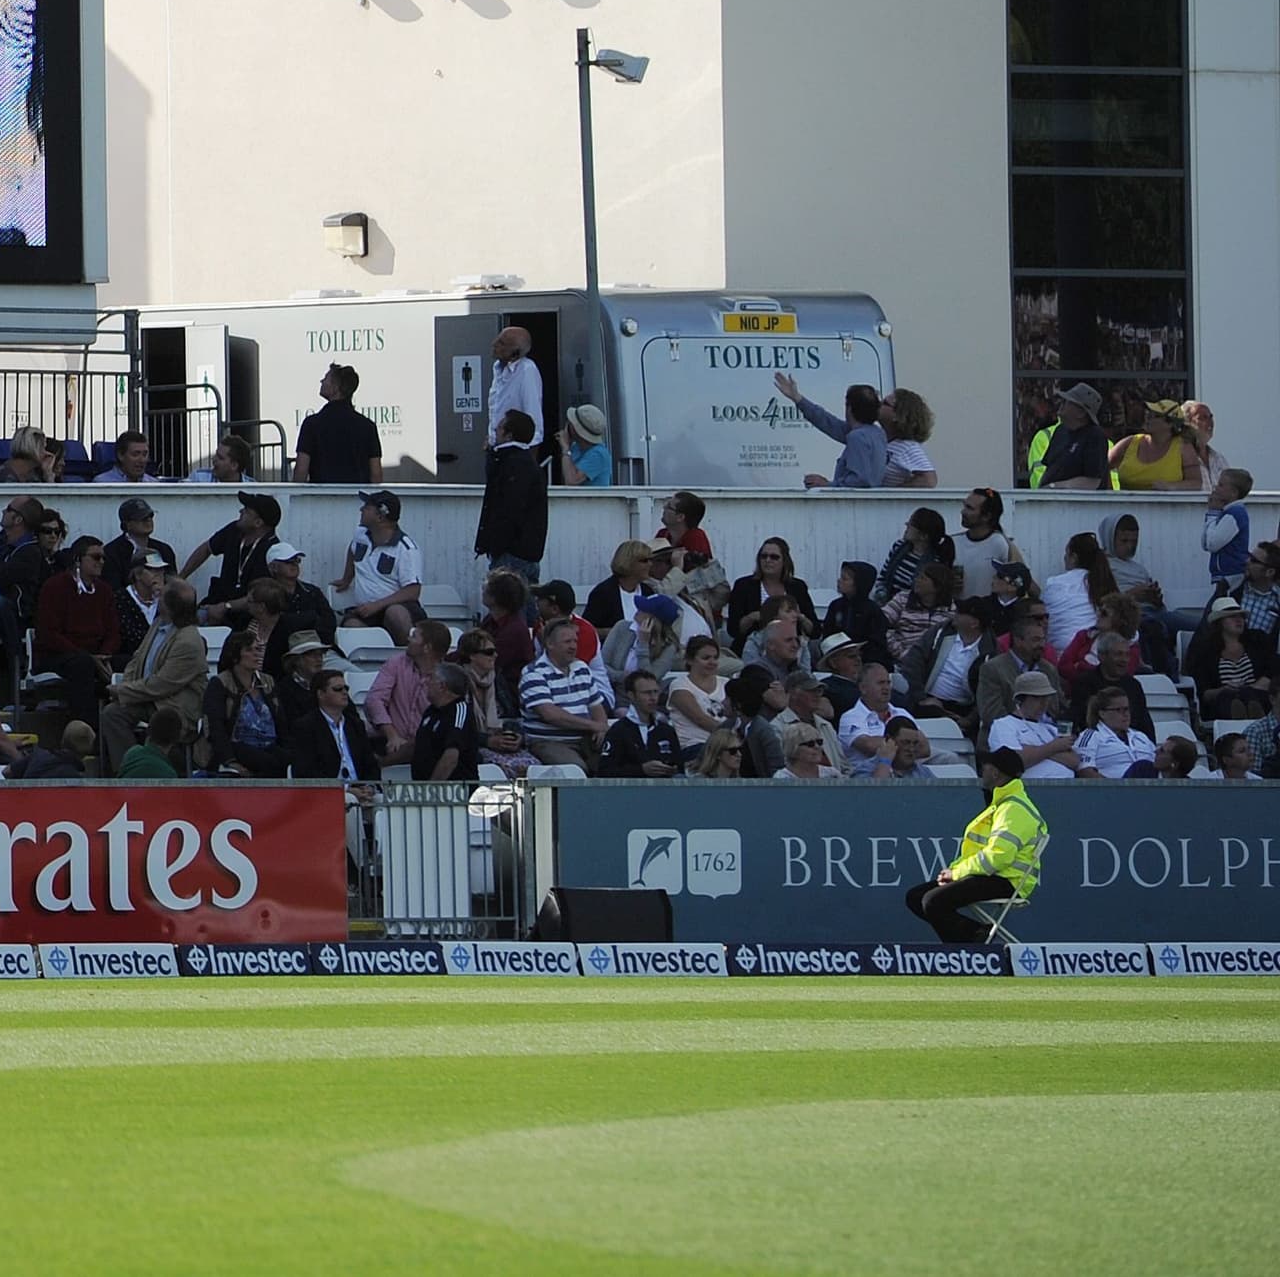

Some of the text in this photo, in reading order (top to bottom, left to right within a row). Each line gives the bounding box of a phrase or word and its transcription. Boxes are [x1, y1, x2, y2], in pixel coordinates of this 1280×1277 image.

[764, 317, 779, 331] JP
[306, 328, 385, 353] TOILETS
[704, 344, 821, 370] TOILETS
[456, 397, 480, 409] GENTS
[692, 852, 737, 873] 1762
[71, 945, 171, 976] Investec
[210, 944, 306, 975] Investec
[340, 943, 438, 975] Investec
[473, 943, 571, 974] Investec
[612, 944, 720, 975] Investec
[756, 944, 861, 974] Investec
[894, 944, 1002, 975] Investec
[1041, 946, 1143, 975] Investec
